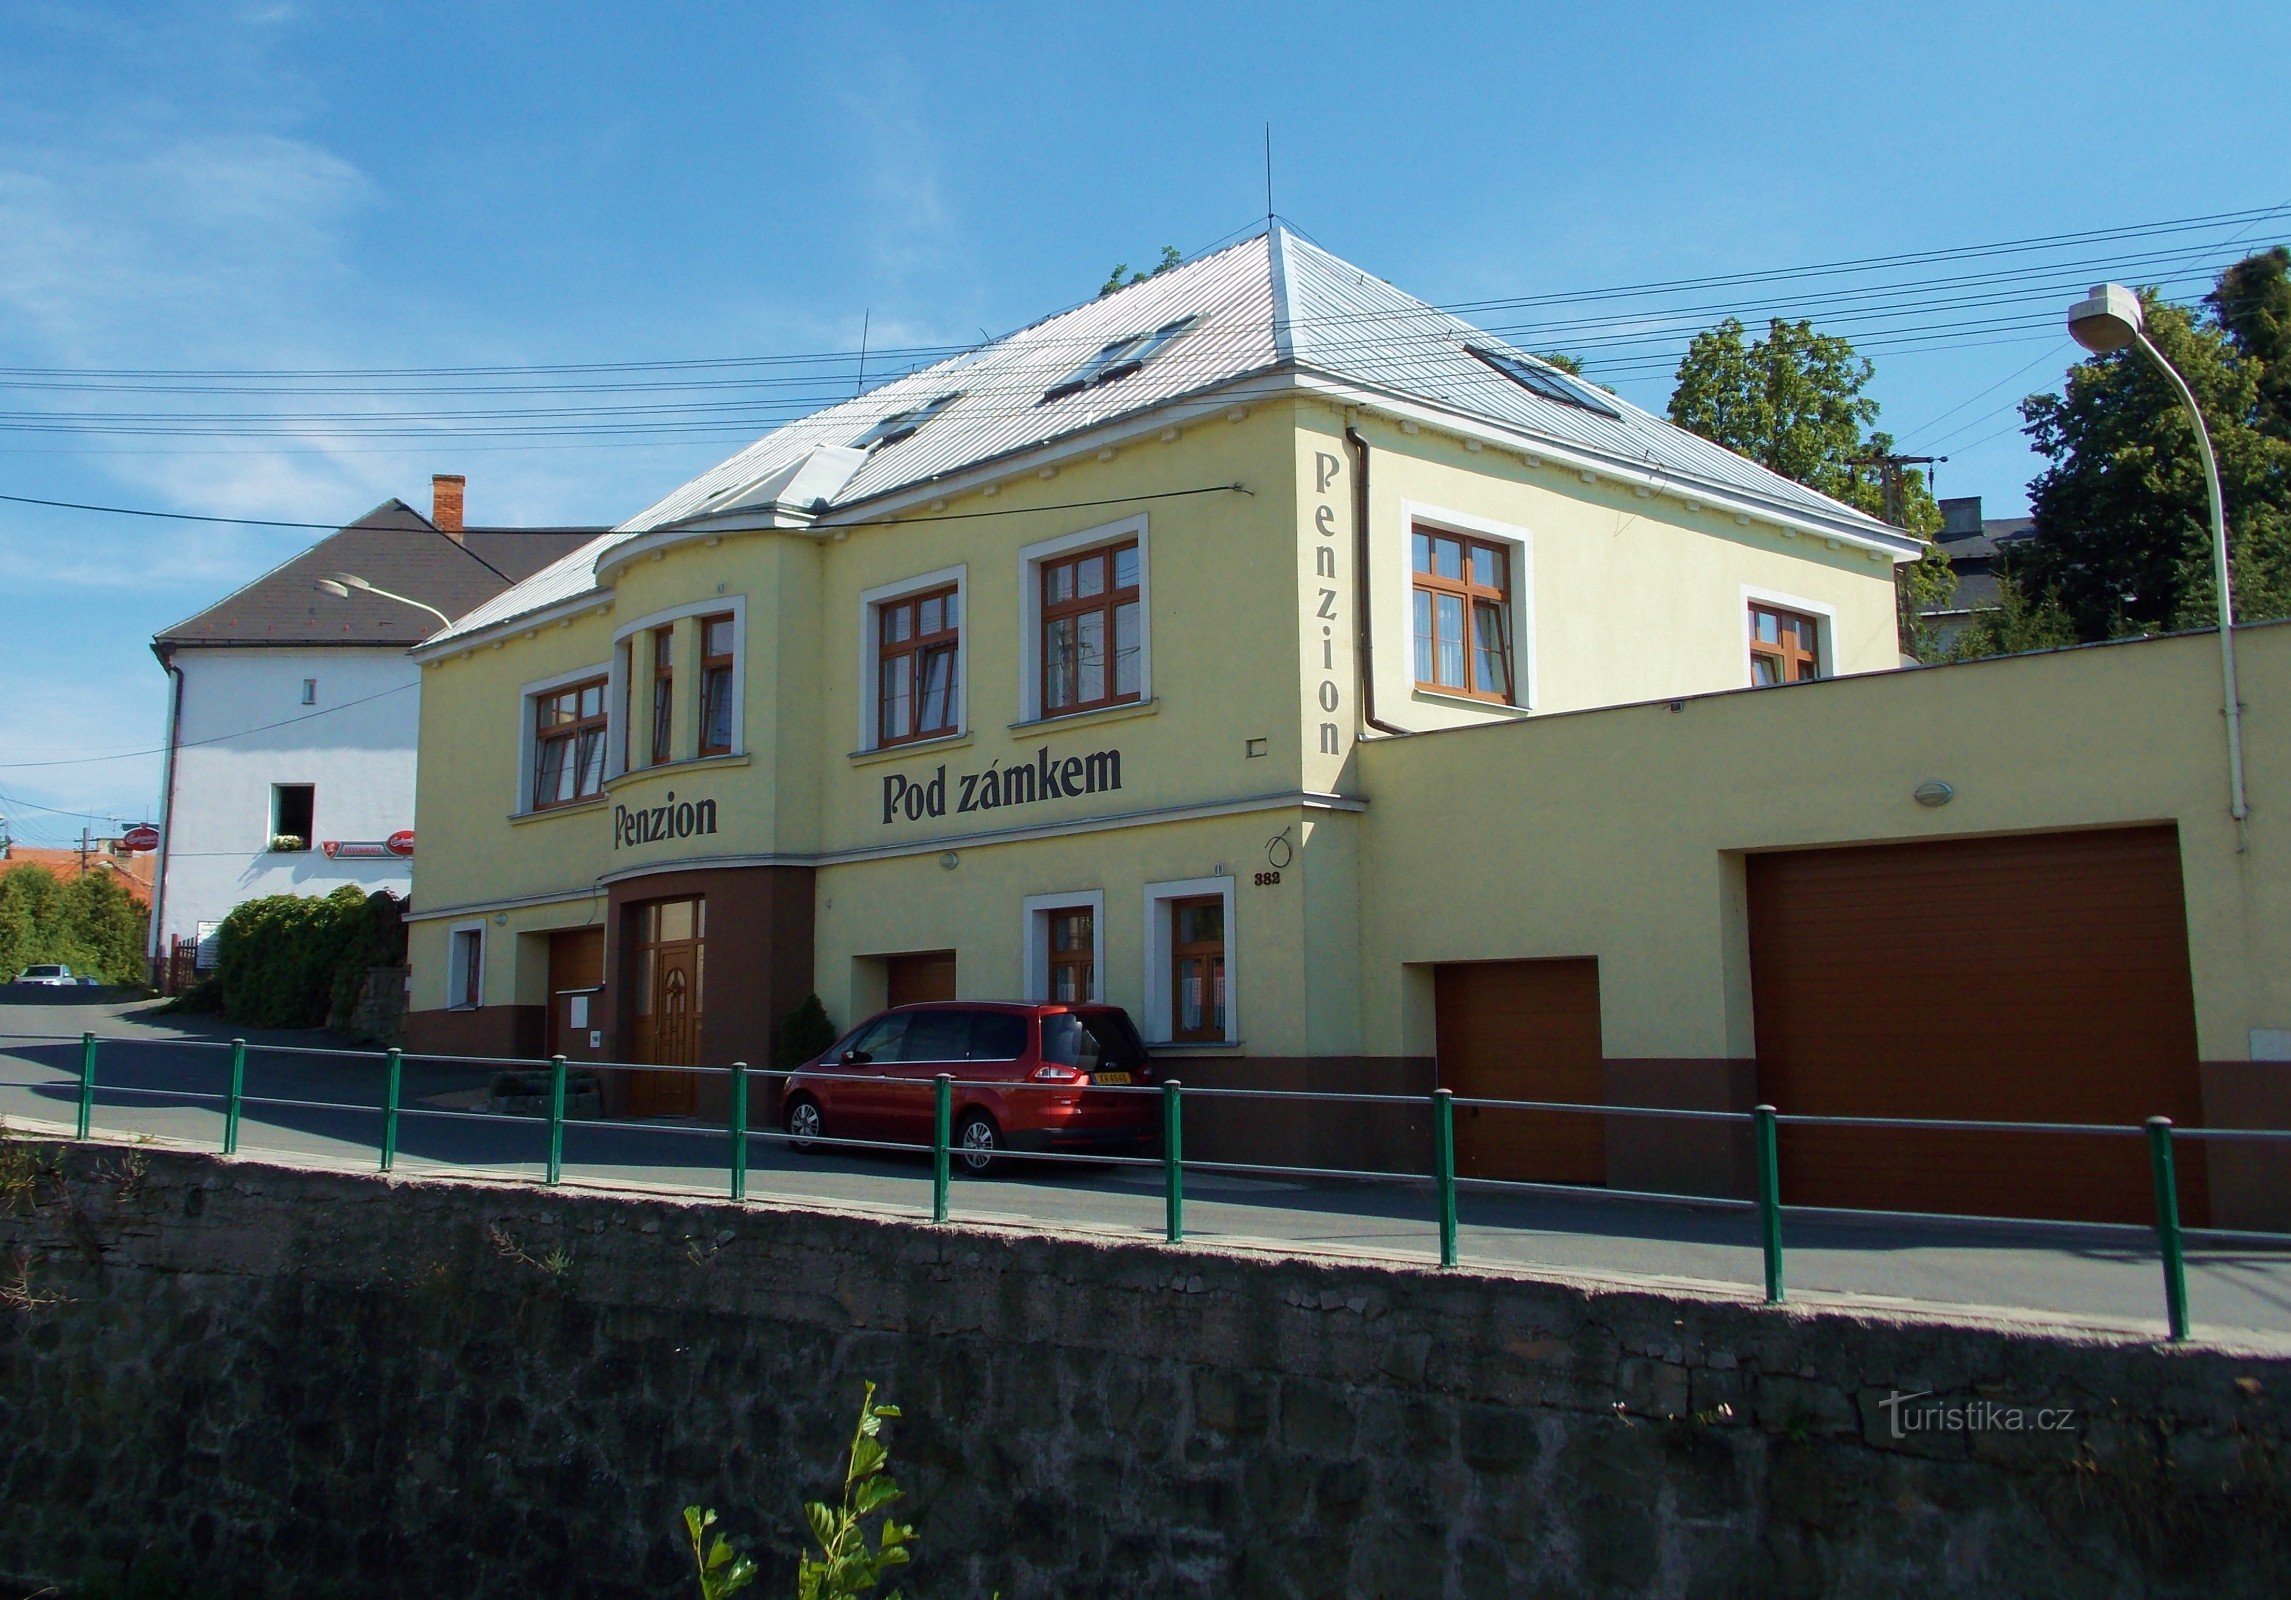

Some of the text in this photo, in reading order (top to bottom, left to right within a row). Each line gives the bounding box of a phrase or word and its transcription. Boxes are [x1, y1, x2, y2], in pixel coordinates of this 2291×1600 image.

[1315, 452, 1341, 756] Penzion
[883, 745, 1122, 824] Pod zámkem
[614, 790, 718, 850] Penzion
[1254, 870, 1281, 887] 382
